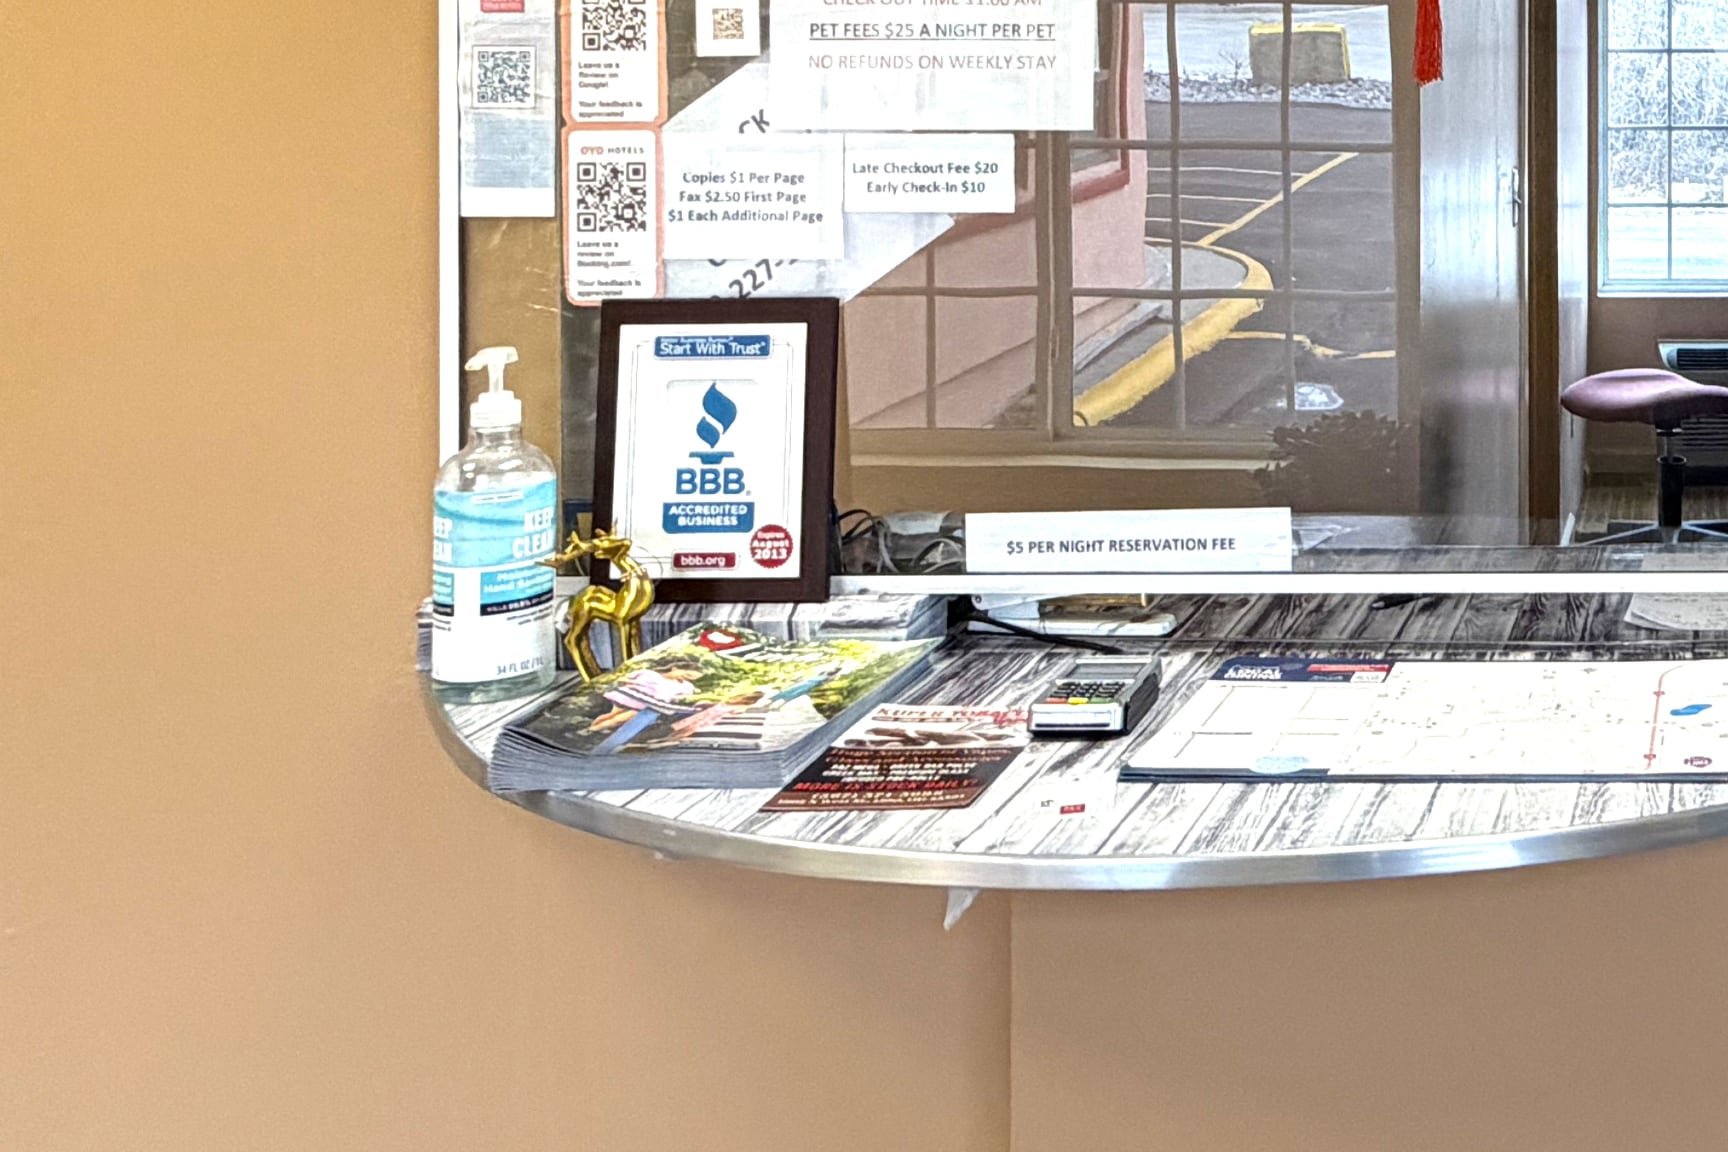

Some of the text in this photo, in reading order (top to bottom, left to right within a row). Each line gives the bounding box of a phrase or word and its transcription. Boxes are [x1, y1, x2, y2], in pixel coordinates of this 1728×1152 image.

[809, 22, 1056, 39] PET FEES $25 A NIGHT PER PET
[808, 55, 1056, 69] NO REFUNDS ON WEEKLY STAY
[580, 146, 645, 155] OYO HOTELS
[852, 161, 998, 176] Late Checkout Fee $20
[682, 171, 805, 187] Copies $1 Per Page
[866, 181, 986, 196] Early Check-In $10
[678, 190, 807, 206] Fax $2.50 First Page
[667, 209, 823, 226] $1 Each Additional Page
[659, 342, 691, 355] Start
[695, 341, 725, 355] With
[675, 467, 746, 495] BBB
[668, 503, 748, 516] ACCREDITED
[677, 515, 738, 527] BUSINESS
[752, 539, 790, 550] August
[1006, 537, 1236, 556] $5 PER NIGHT RESERVATION FEE
[680, 553, 726, 568] bbb.org
[753, 548, 788, 560] 2013
[793, 783, 839, 791] MORE
[868, 782, 914, 791] STOCK
